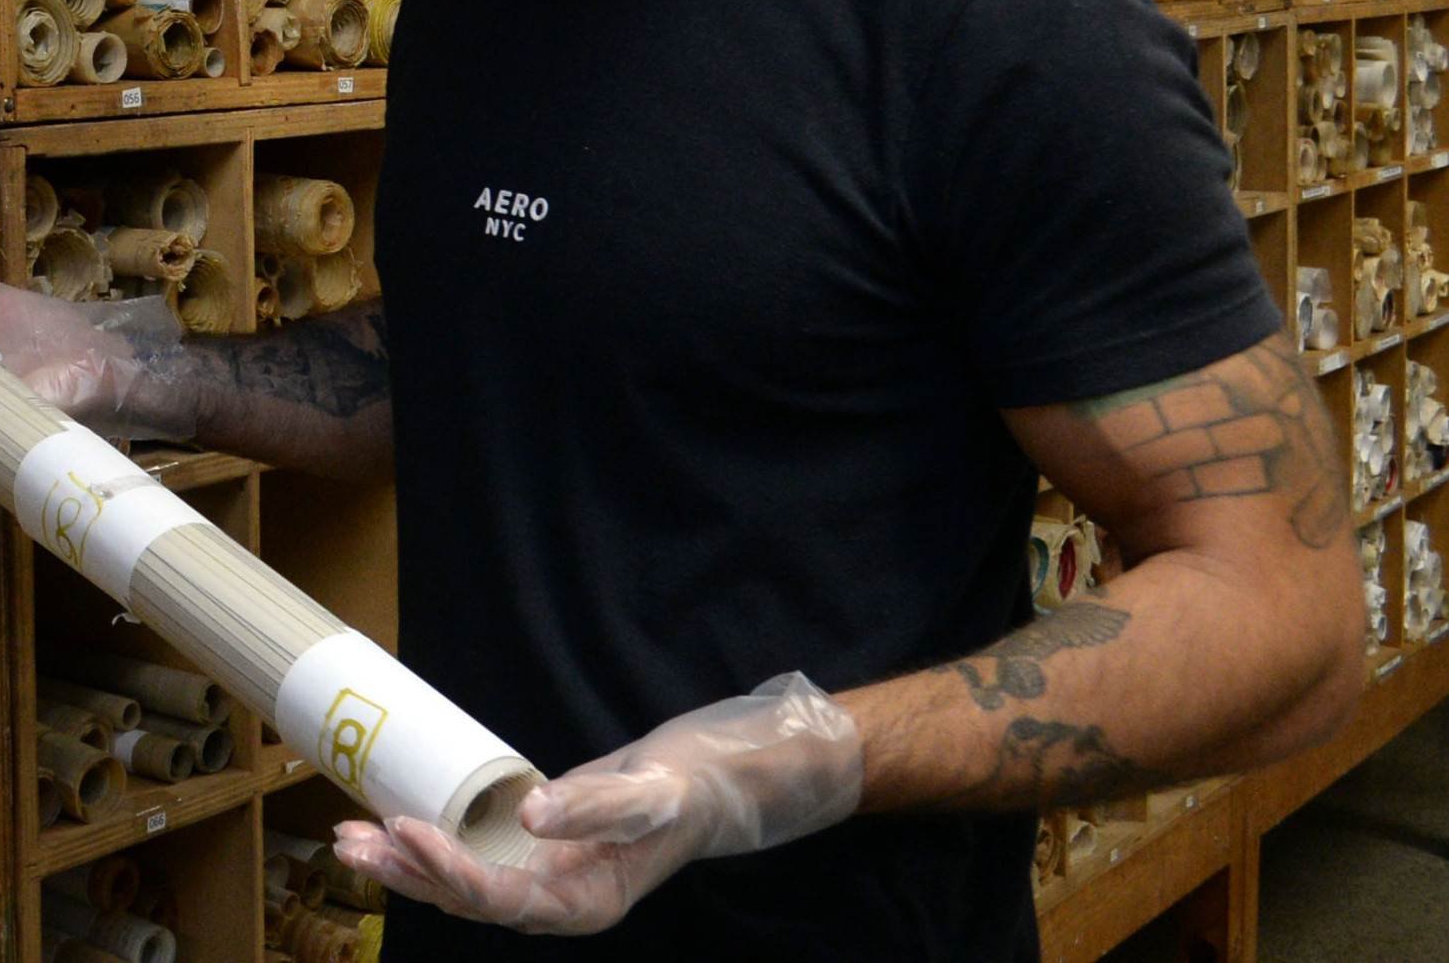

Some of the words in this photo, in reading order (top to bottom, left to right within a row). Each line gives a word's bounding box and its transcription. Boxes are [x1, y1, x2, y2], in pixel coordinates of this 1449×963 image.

[124, 93, 140, 105] 056
[474, 187, 549, 221] AERO
[485, 217, 526, 242] NYC
